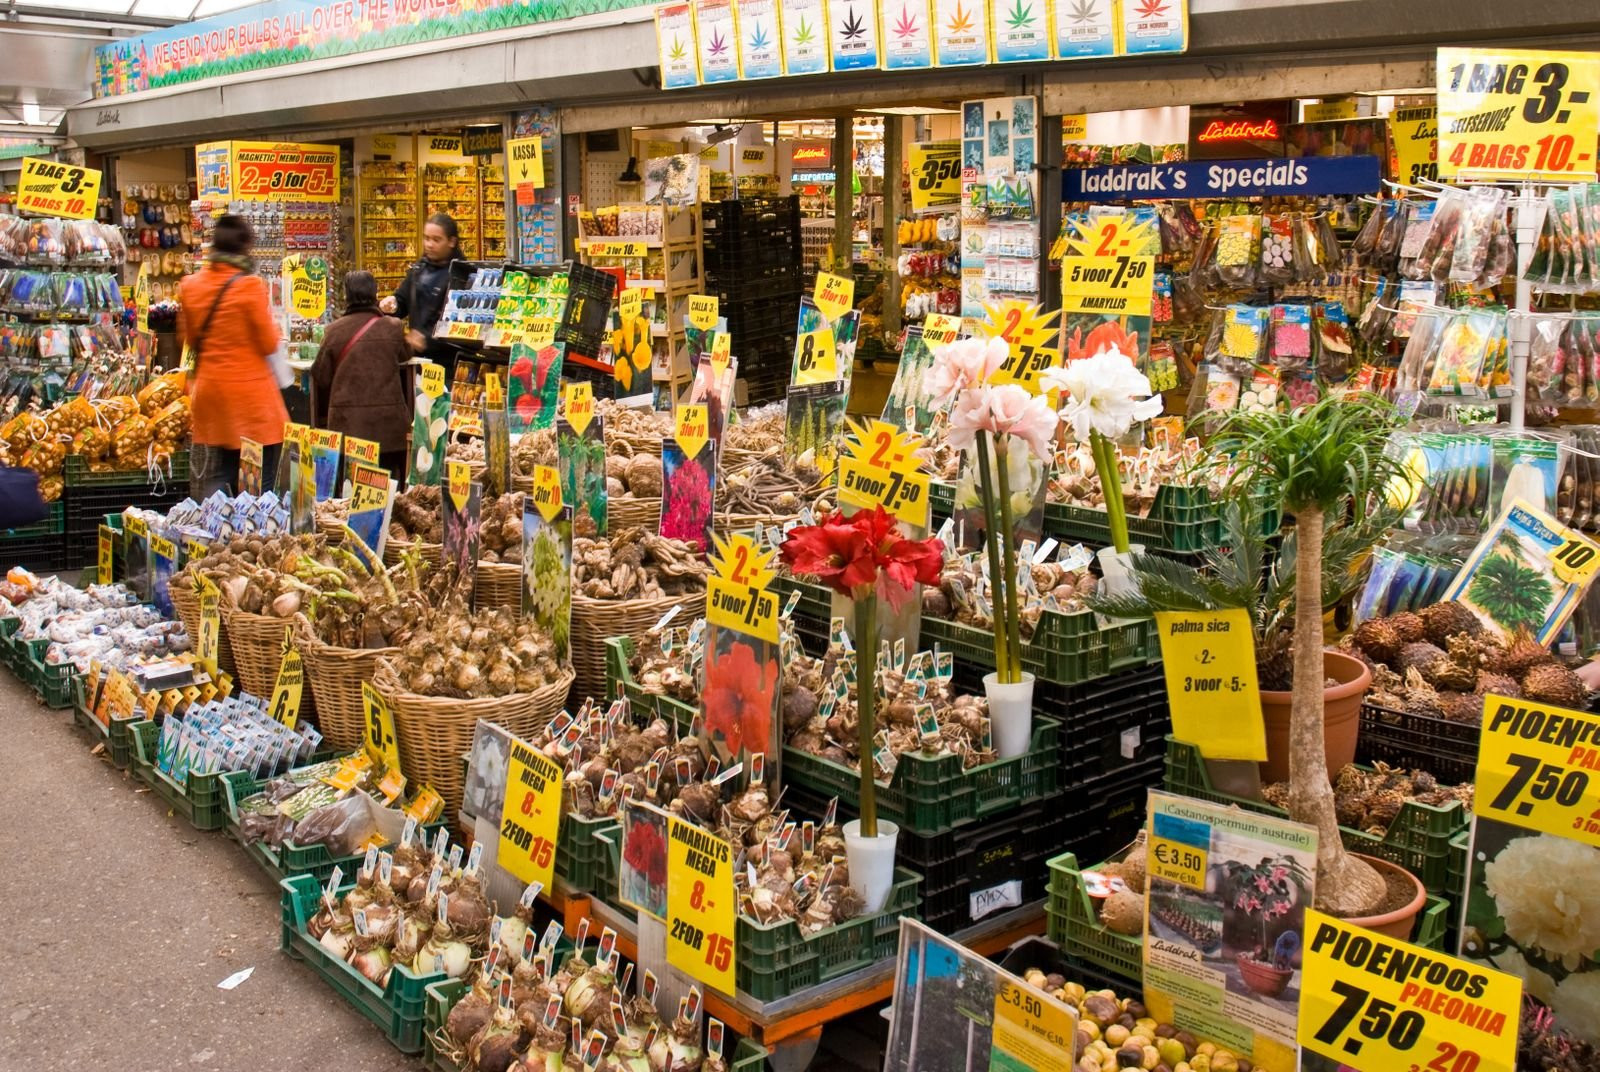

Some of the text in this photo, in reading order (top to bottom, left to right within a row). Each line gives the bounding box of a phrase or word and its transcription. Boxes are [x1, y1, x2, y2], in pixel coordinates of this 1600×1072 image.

[152, 42, 170, 65] WE
[171, 34, 201, 63] SEND
[203, 26, 236, 53] YOUR
[238, 17, 280, 47] BULBS
[283, 12, 309, 38] ALL
[312, 2, 353, 32] OVER
[359, 0, 389, 22] THE
[1450, 62, 1591, 124] 1 BAG 3.-
[1198, 119, 1277, 142] Laddrak
[1449, 105, 1517, 134] SELFSERVICE
[238, 152, 336, 164] MAGNETIC MEMO HOLDERS
[430, 138, 461, 151] SEEDS
[512, 143, 537, 161] KASSA
[742, 149, 765, 161] SEEDS
[1448, 134, 1591, 172] 4 BAGS 10.-
[27, 162, 95, 195] 1 BAG 3.-
[271, 170, 284, 189] 3
[284, 170, 309, 189] for
[1080, 159, 1308, 193] laddrak's Specials
[22, 195, 31, 206] 4
[31, 196, 64, 211] BAGS
[606, 246, 613, 255] 3
[612, 246, 622, 255] for
[1095, 223, 1131, 257] 2.-
[1070, 256, 1147, 290] 5 voor 7.50
[690, 301, 708, 312] CALLA
[838, 293, 849, 306] 10
[1079, 297, 1128, 310] AMARYLLIS
[525, 323, 544, 333] CALLA
[942, 330, 956, 344] 10
[799, 334, 826, 372] 8.-
[1012, 344, 1053, 382] 7.50
[696, 423, 705, 438] 10
[868, 431, 905, 470] 2.-
[551, 485, 561, 506] 10
[844, 470, 921, 511] 5 voor 7.50
[730, 545, 758, 586] 2.-
[711, 586, 773, 628] 5 voor 7.50
[1170, 618, 1231, 636] palma sica
[1184, 676, 1193, 693] 3
[1194, 676, 1222, 692] voor
[511, 744, 559, 784] AMARILLYS
[520, 769, 546, 795] MEGA
[1489, 752, 1590, 817] 7.50
[520, 790, 543, 818] 8.-
[1261, 826, 1311, 846] australe)
[1572, 816, 1585, 830] 3
[671, 821, 730, 865] AMARILLYS
[685, 848, 717, 879] MEGA
[1156, 865, 1163, 875] 3
[1163, 869, 1180, 879] voor
[689, 879, 716, 913] 8.-
[1150, 939, 1199, 963] Laddrak
[1309, 921, 1490, 1000] PIOENroos
[1312, 978, 1427, 1057] 7.50
[1398, 980, 1508, 1038] PAEONIA
[1024, 1018, 1030, 1029] 3
[1031, 1023, 1047, 1036] voor
[1426, 1041, 1482, 1072] 20
